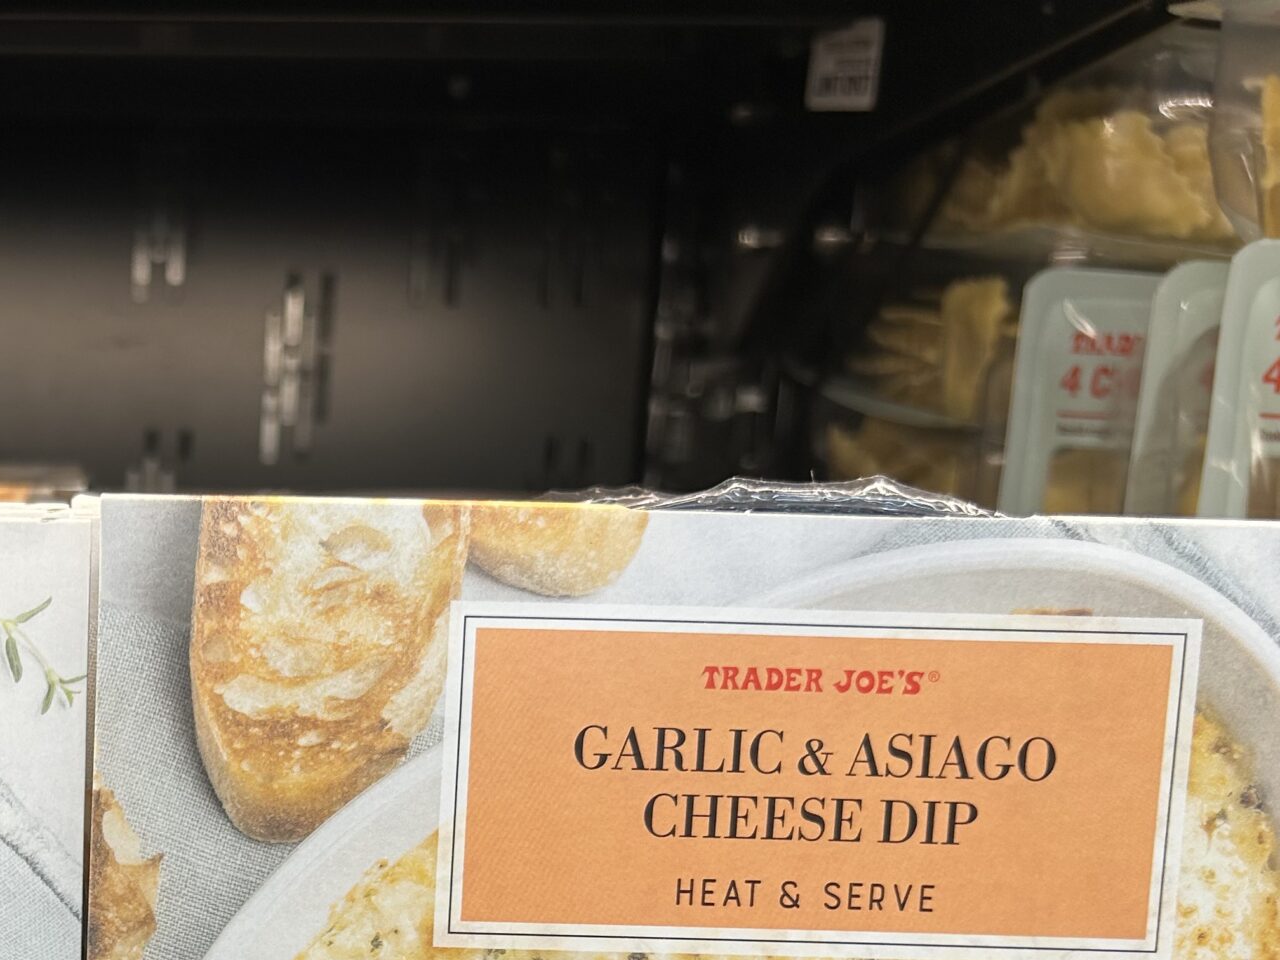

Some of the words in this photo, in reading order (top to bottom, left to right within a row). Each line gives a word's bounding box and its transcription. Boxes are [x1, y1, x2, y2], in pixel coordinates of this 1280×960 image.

[1060, 365, 1082, 393] 4
[701, 666, 823, 692] TRADER
[573, 724, 784, 775] GARLIC
[796, 738, 833, 776] &
[845, 733, 1058, 782] ASIAGO
[643, 793, 863, 843] CHEESE
[878, 799, 979, 845] DIP
[676, 878, 762, 907] HEAT
[778, 880, 801, 909] &
[823, 882, 936, 913] SERVE
